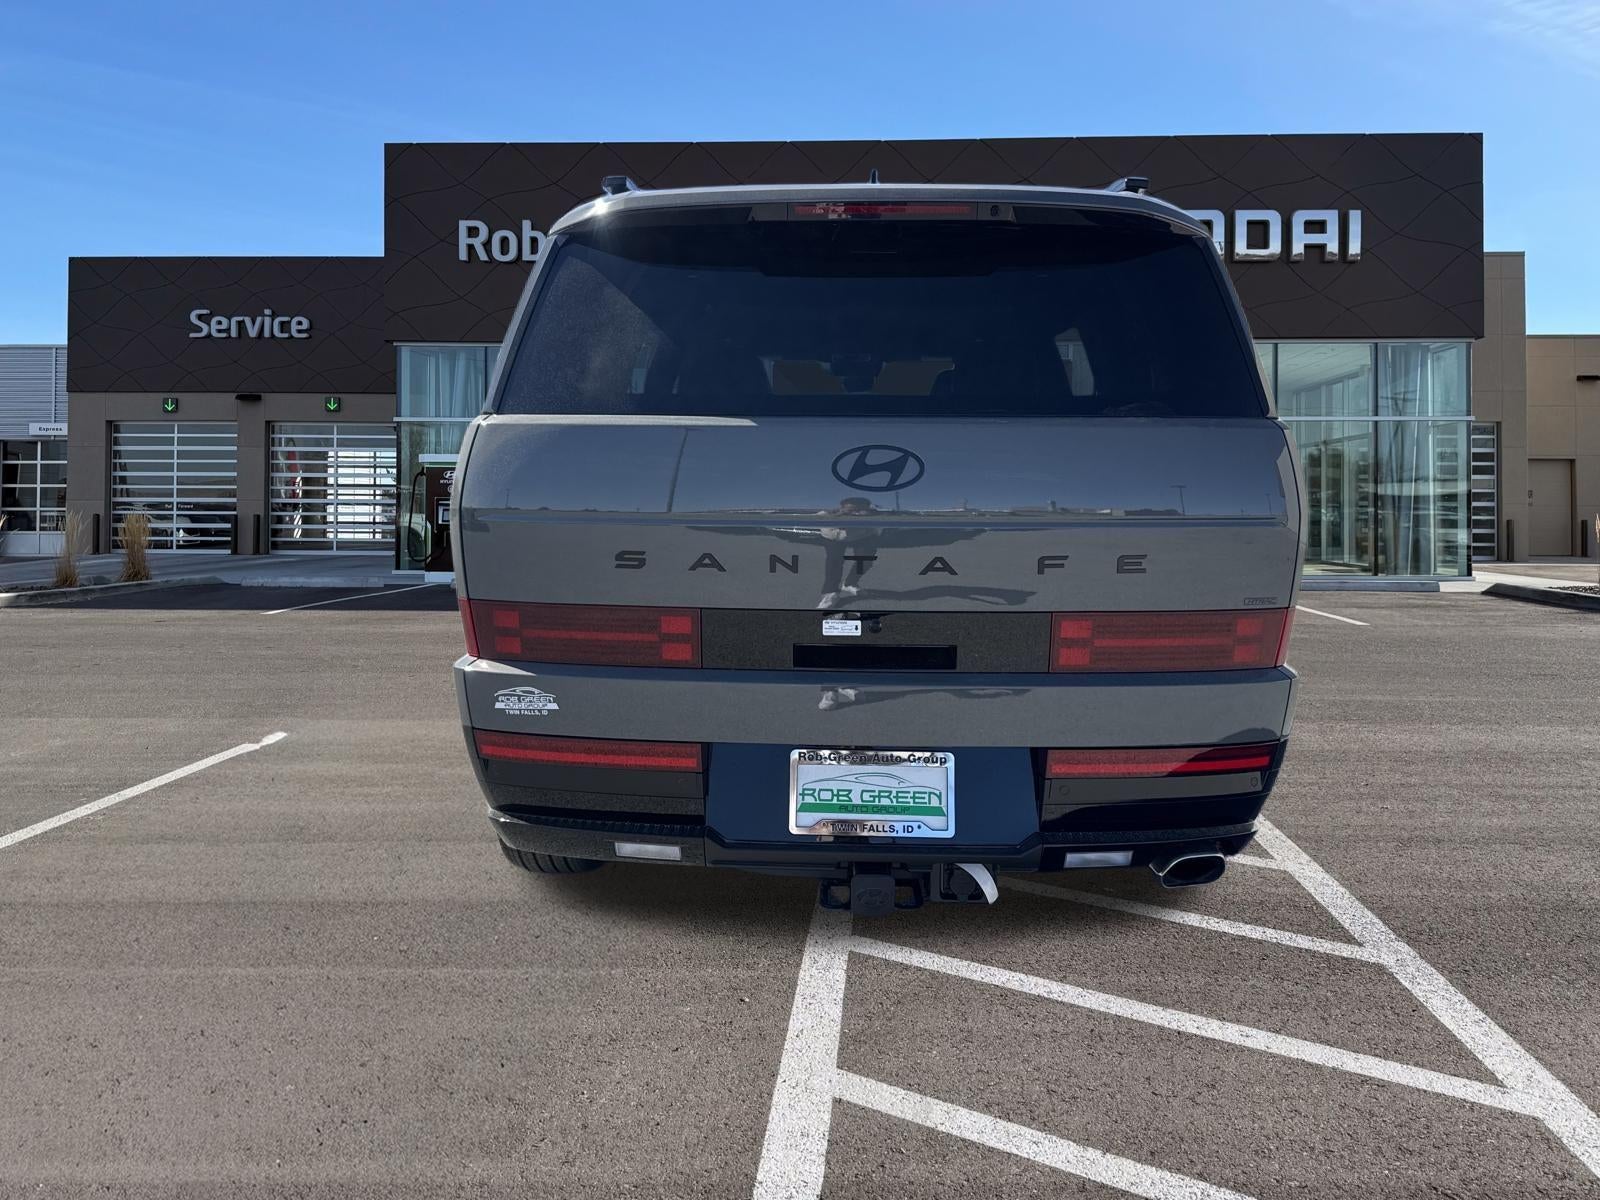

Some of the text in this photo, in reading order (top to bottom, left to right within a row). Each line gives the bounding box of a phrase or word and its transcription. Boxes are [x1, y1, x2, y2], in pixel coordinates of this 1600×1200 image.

[458, 219, 547, 262] Rob
[188, 308, 311, 338] Service
[613, 550, 1148, 576] SANTA FE
[521, 709, 541, 717] FALLS,
[799, 788, 942, 805] ROB GREEN
[838, 805, 911, 814] AUTO GROUP
[830, 823, 914, 835] TWIN FALLS, ID
